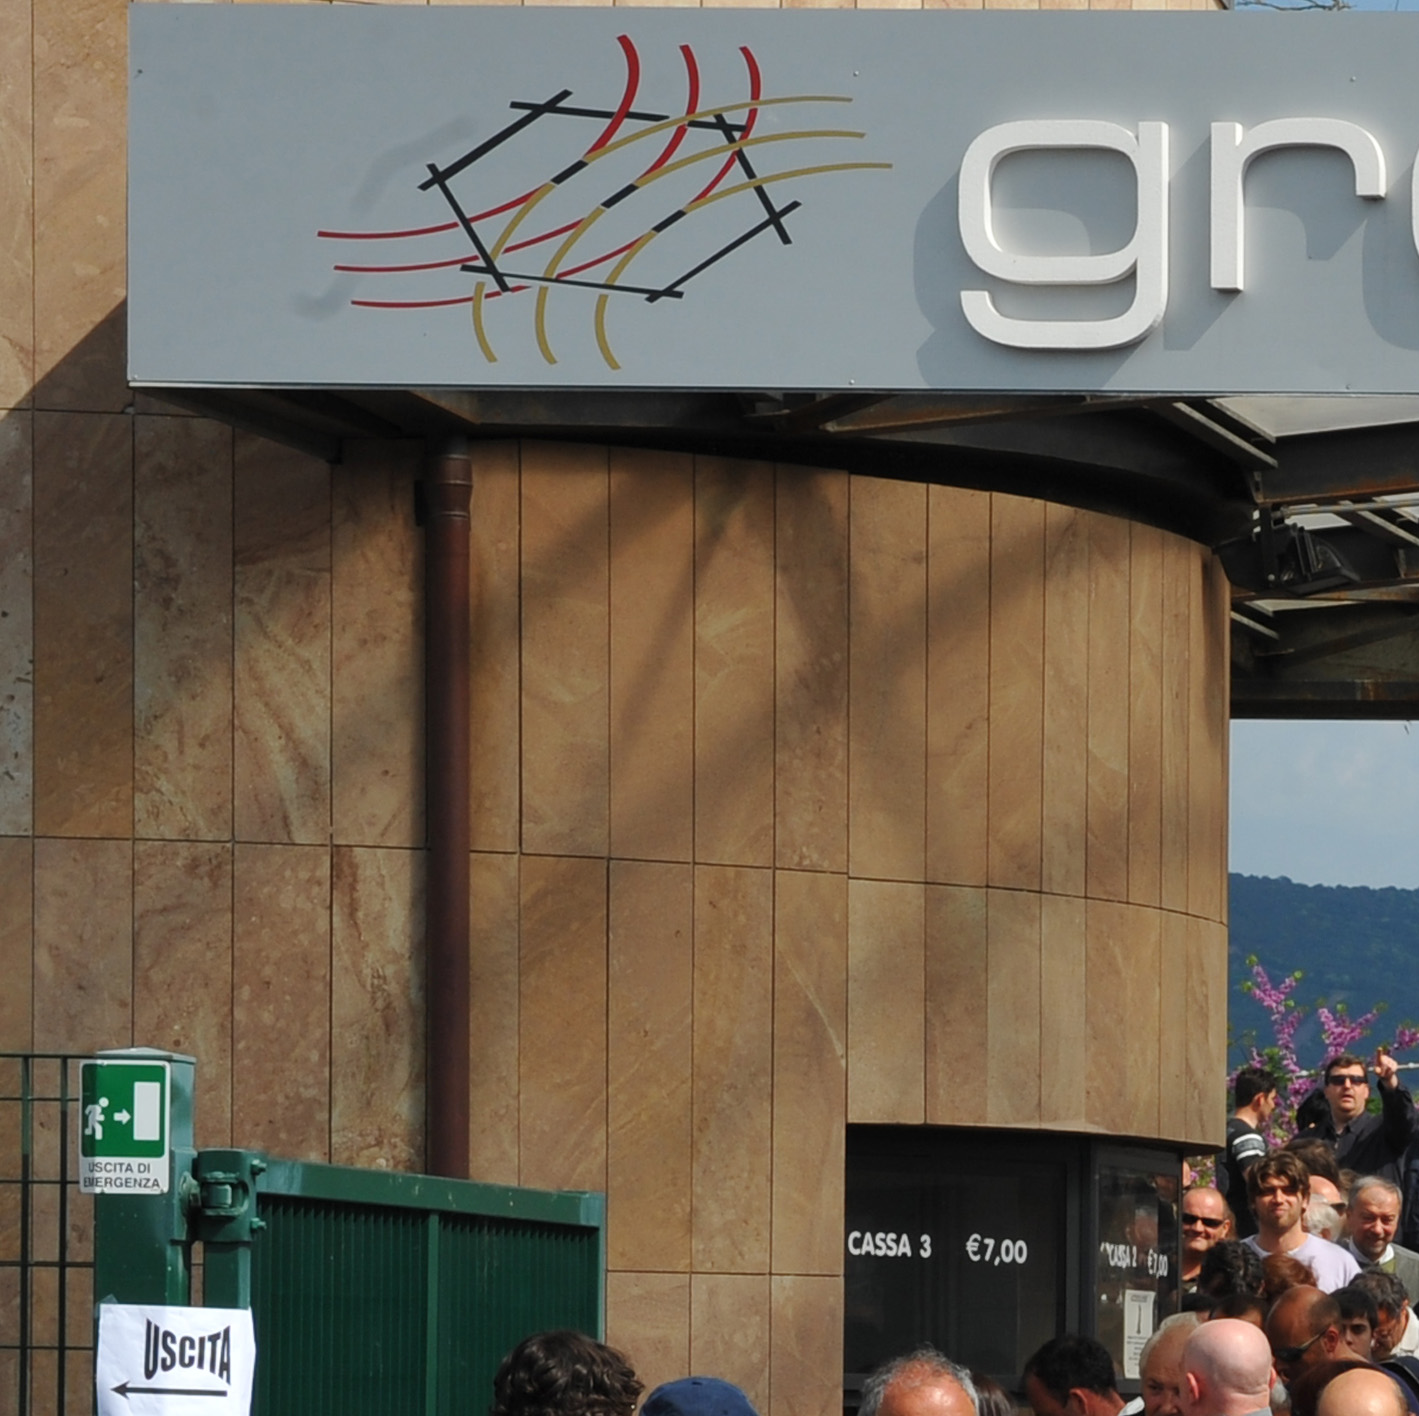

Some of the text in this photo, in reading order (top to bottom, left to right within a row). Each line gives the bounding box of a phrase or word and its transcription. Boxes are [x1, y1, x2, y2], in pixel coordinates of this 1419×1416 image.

[88, 1162, 151, 1174] USCITA DI
[848, 1231, 1028, 1266] CASSA 3 €7,00
[143, 1318, 231, 1386] USCITA
